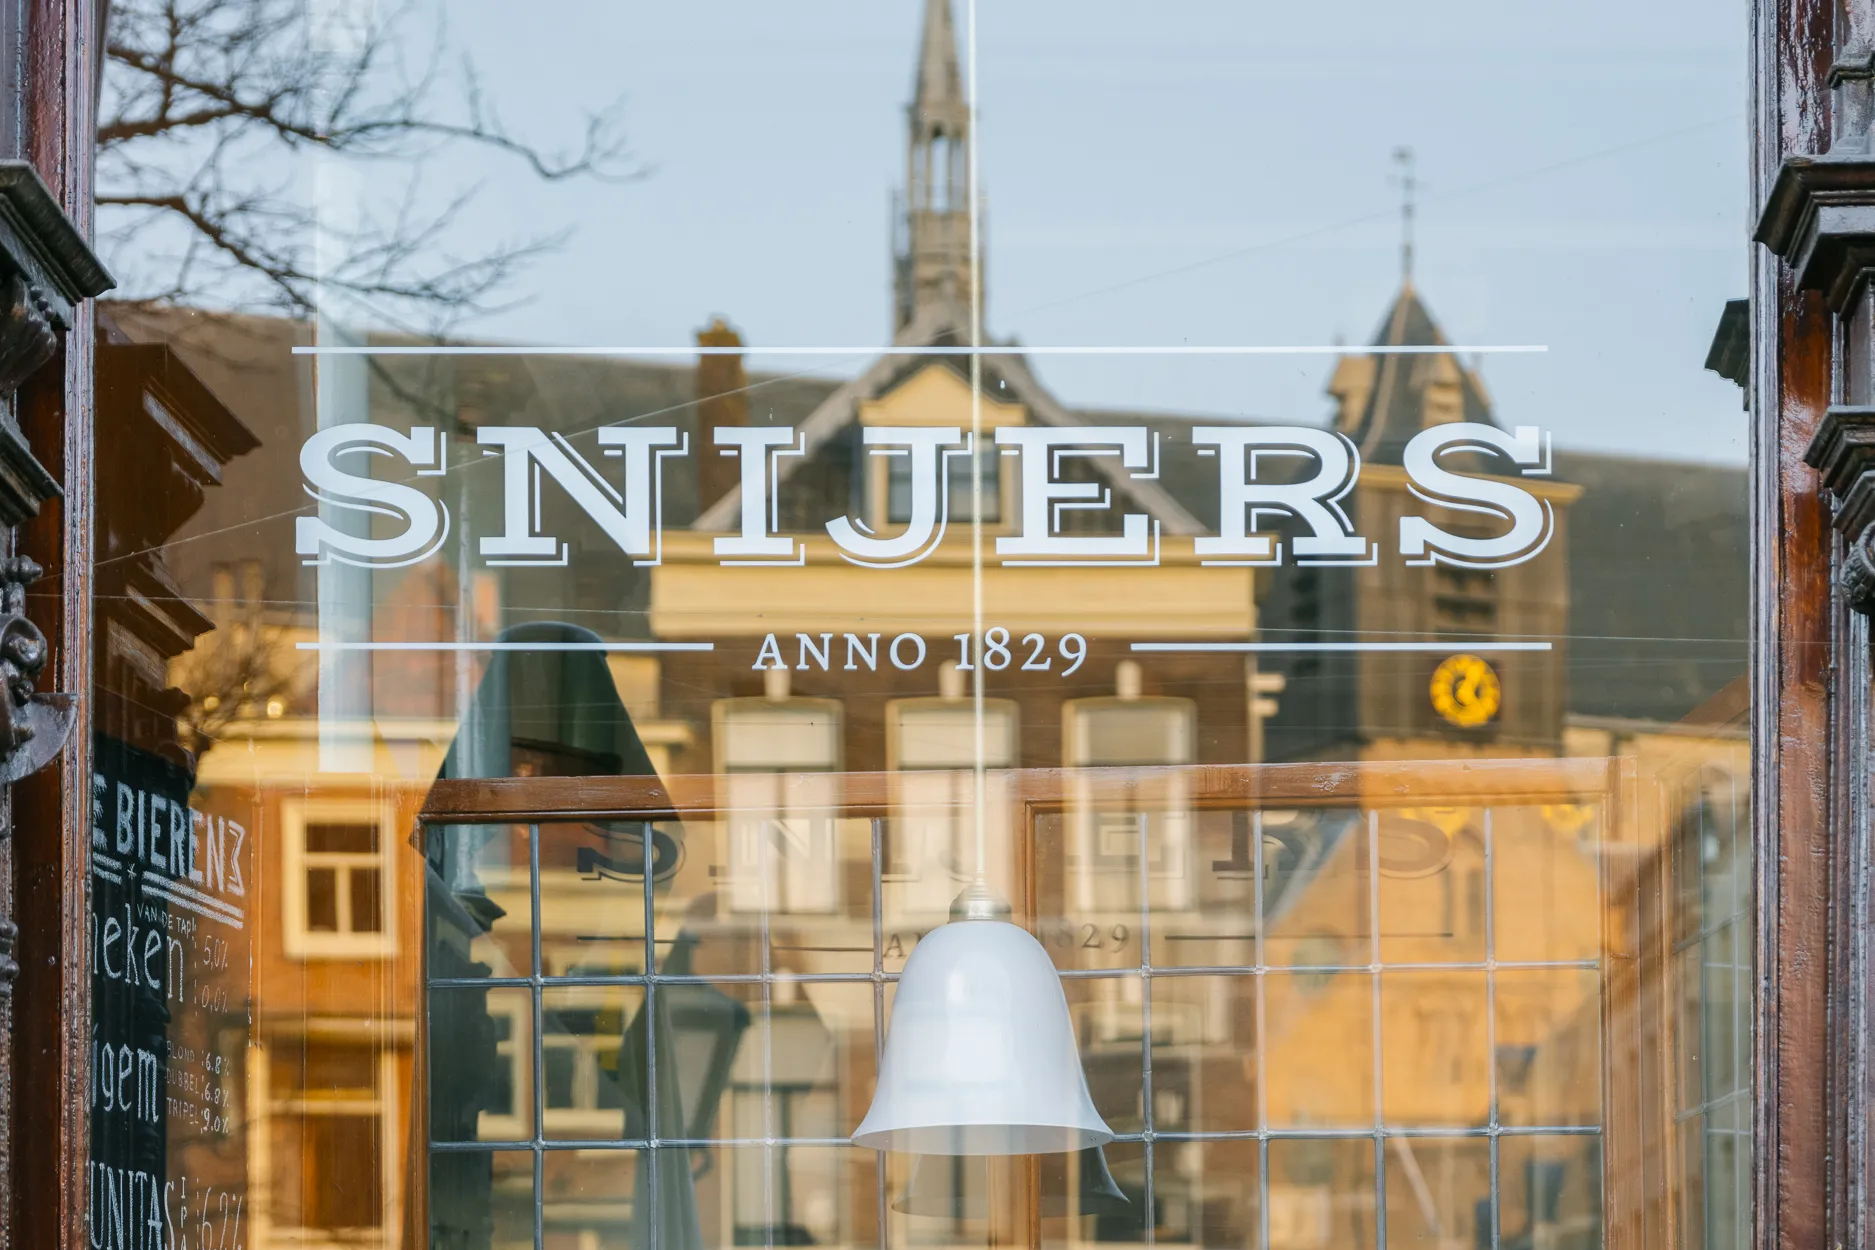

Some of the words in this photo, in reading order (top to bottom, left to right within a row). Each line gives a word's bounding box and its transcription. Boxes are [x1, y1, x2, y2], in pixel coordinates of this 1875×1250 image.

[295, 423, 1554, 568] SNIJERS
[751, 633, 926, 671] ANNO
[953, 627, 1087, 677] 1829
[116, 780, 224, 894] BIEREN
[136, 903, 158, 922] VAN
[161, 913, 174, 931] DE
[166, 1040, 195, 1062] BLOND
[166, 1068, 199, 1094] DUBBEL
[166, 1097, 199, 1125] TRIPEL
